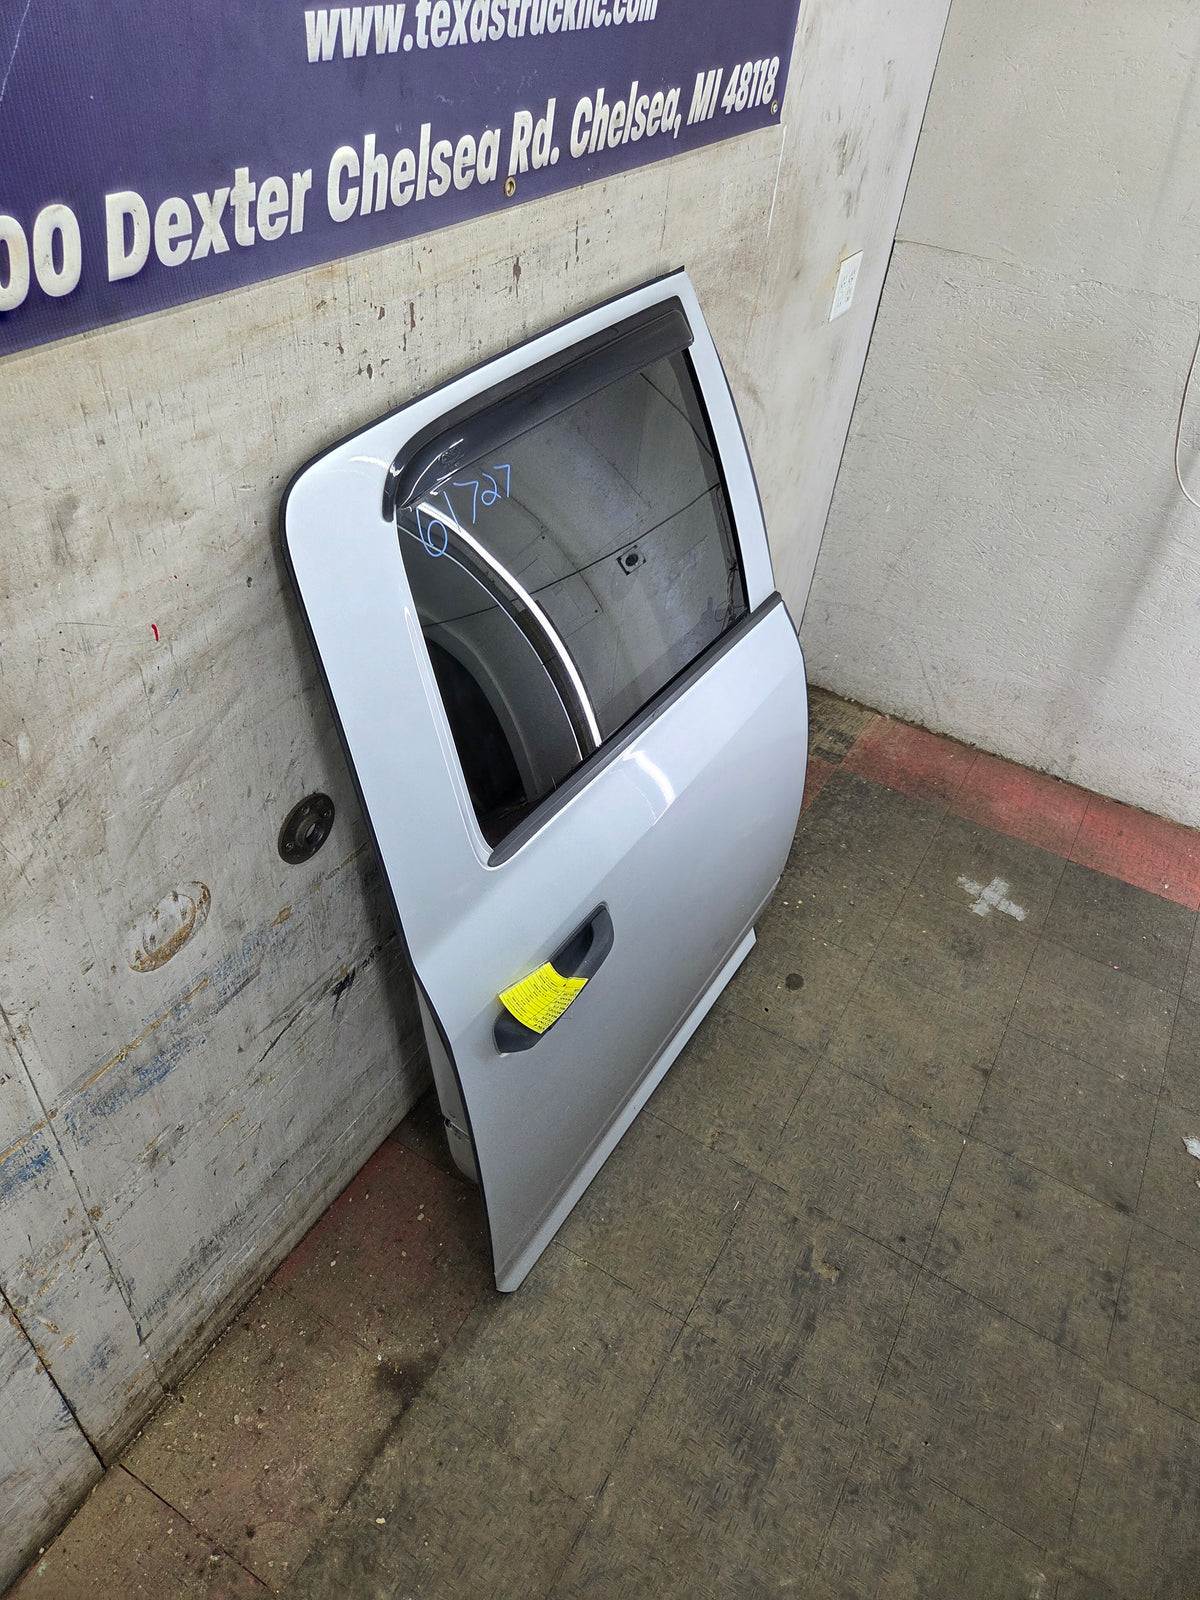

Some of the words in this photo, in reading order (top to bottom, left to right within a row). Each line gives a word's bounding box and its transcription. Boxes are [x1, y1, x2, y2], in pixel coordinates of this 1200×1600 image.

[105, 167, 312, 282] Dexter
[327, 122, 501, 223] Chelsea
[508, 97, 560, 177] Rd.
[570, 80, 681, 159] Chelsea,
[686, 68, 724, 126] MI
[721, 55, 780, 115] 48118
